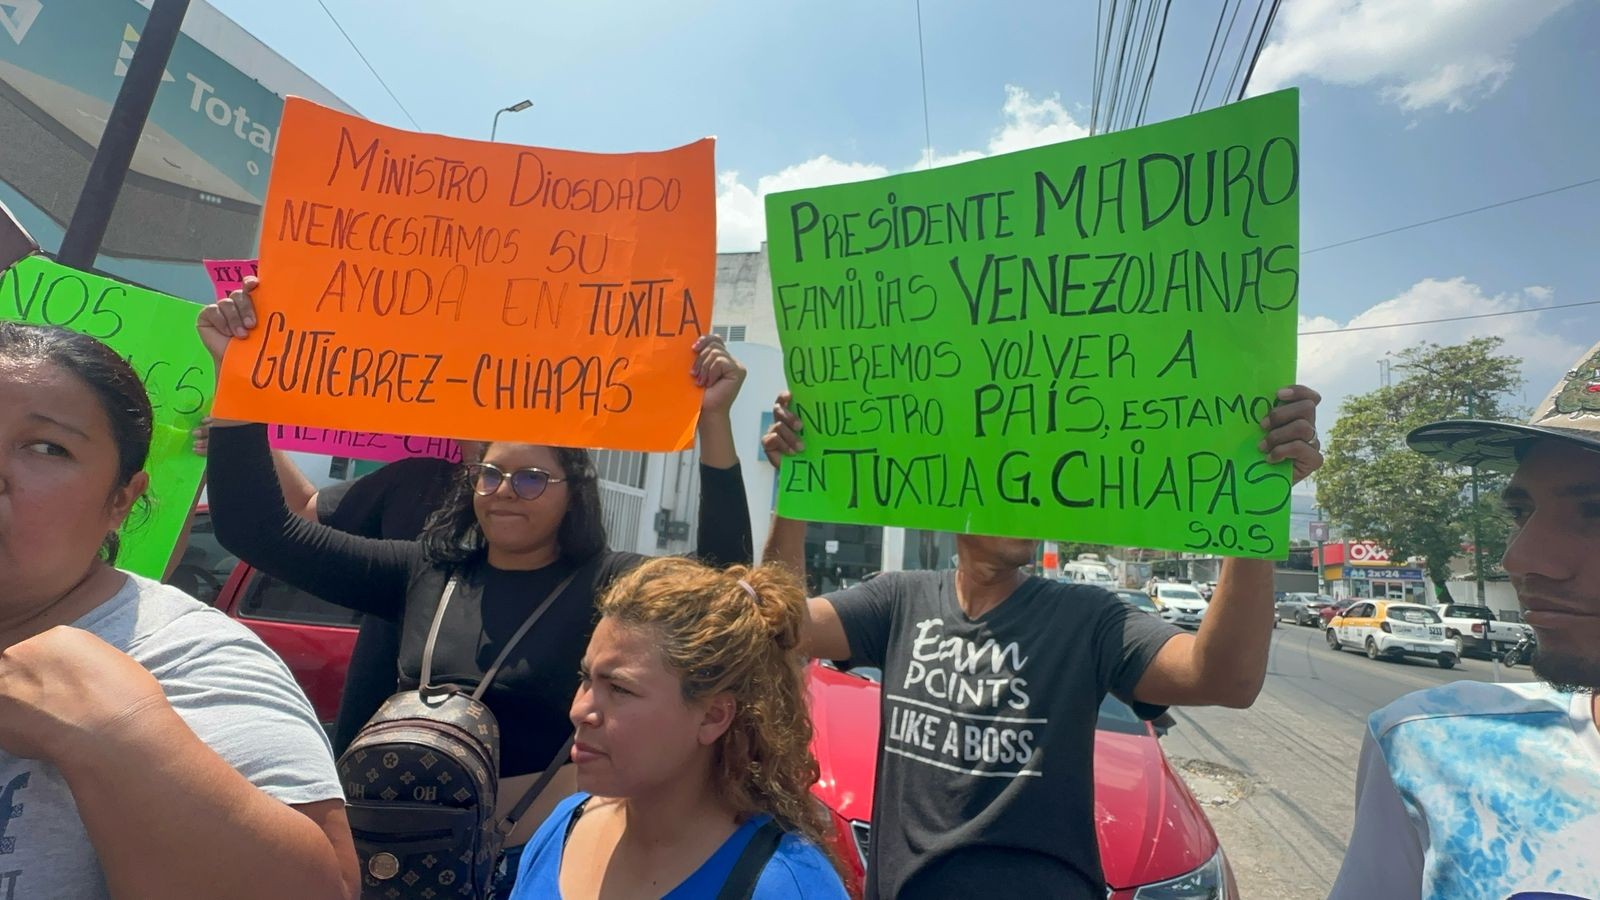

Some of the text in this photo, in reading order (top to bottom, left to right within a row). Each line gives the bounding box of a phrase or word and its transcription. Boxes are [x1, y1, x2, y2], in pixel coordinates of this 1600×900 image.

[1033, 136, 1300, 239] MADURO
[546, 229, 609, 275] SU
[315, 259, 702, 338] AYUDA EN TUXTLA
[949, 244, 1300, 326] VENEZOLANAS
[789, 328, 1199, 396] QUEREMOS VOLVER A
[796, 394, 944, 438] NUESTRO
[1120, 393, 1279, 431] ESTAMO
[785, 459, 828, 493] EN
[823, 447, 985, 510] TUXTLA
[996, 449, 1041, 509] G.
[1350, 544, 1392, 561] OXX
[912, 618, 1028, 675] Earn
[903, 660, 1030, 710] POINTS
[889, 706, 1033, 764] LIKE A BOSS
